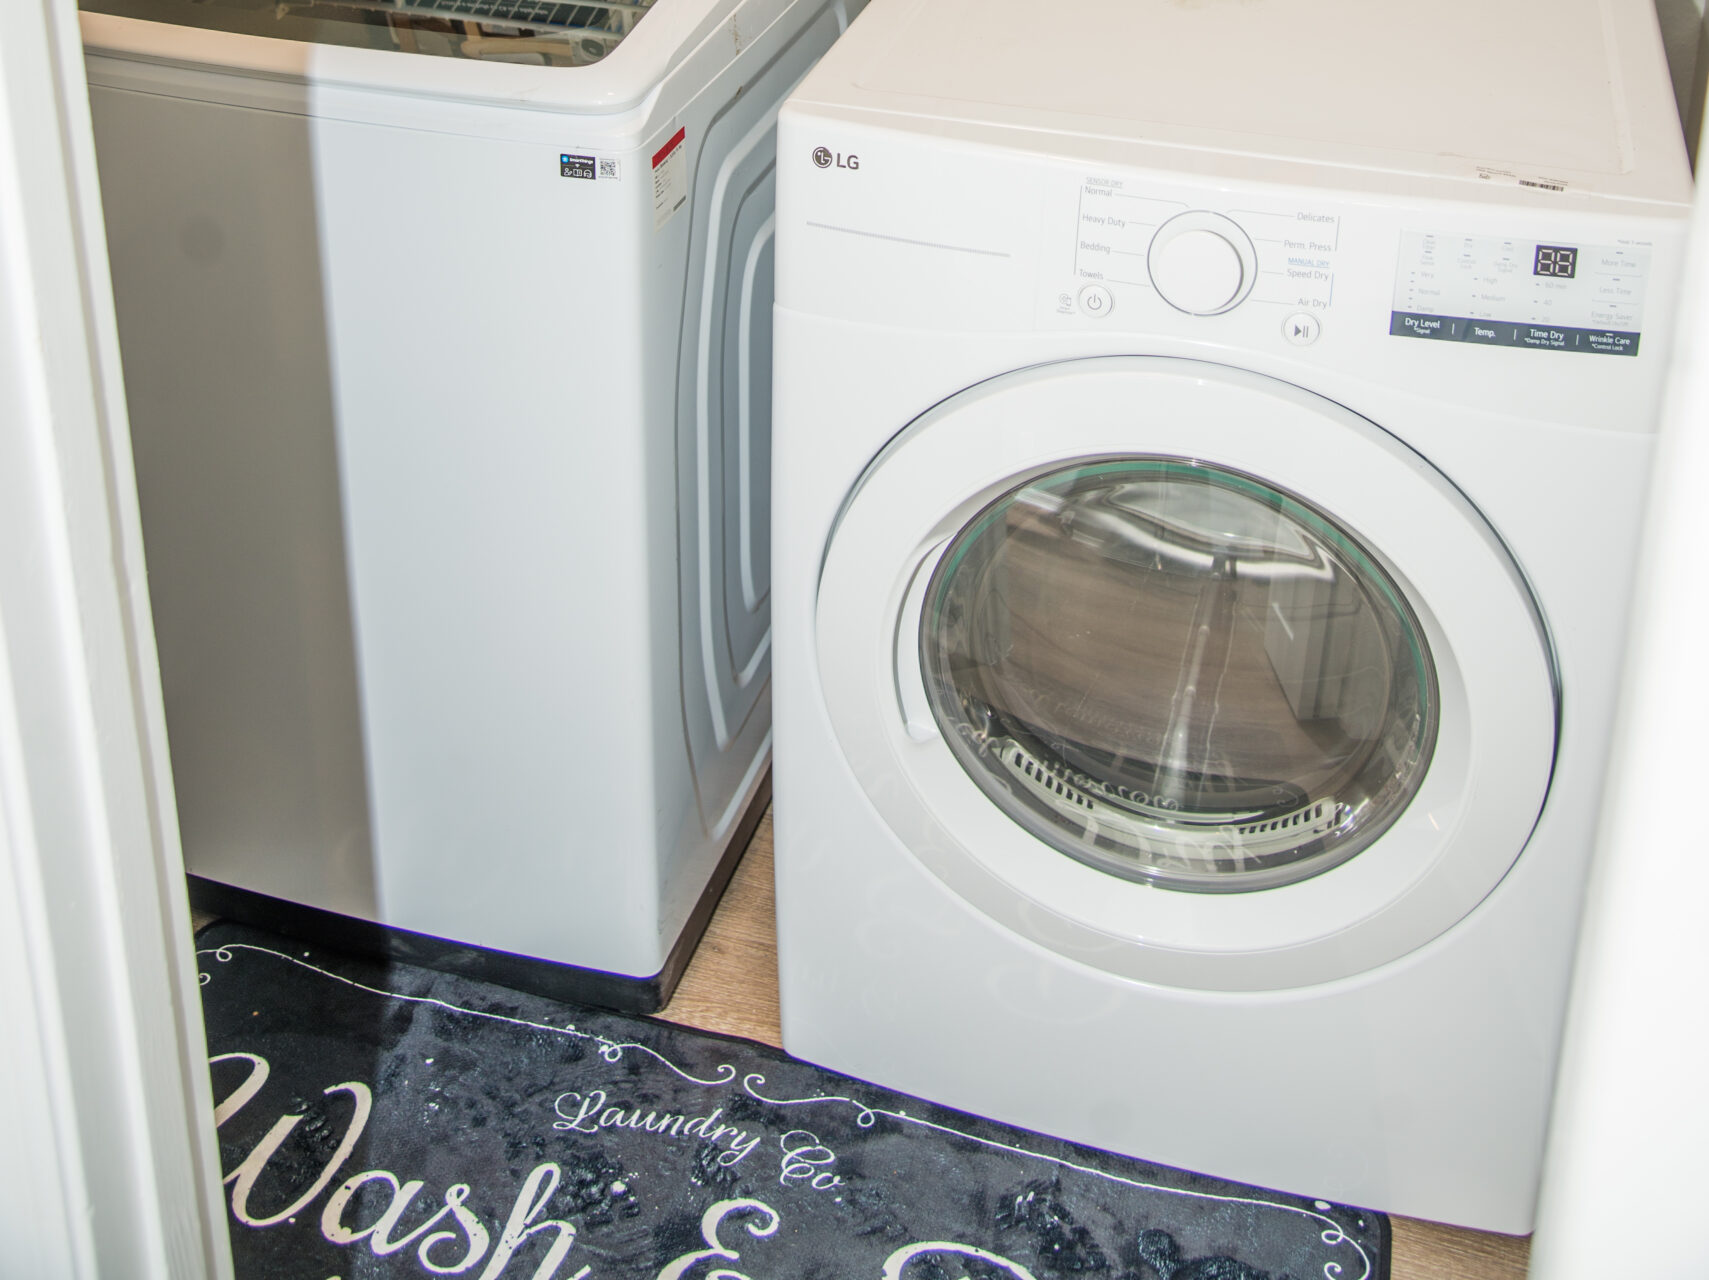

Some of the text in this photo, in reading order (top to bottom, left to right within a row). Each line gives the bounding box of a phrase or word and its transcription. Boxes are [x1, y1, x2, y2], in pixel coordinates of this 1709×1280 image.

[836, 152, 859, 170] LG
[1085, 186, 1113, 197] Normal
[1082, 213, 1126, 229] Heavy Duty
[1297, 212, 1335, 224] Delicates
[1080, 241, 1111, 255] Bedding
[1284, 240, 1332, 252] Perm. Press
[1288, 257, 1330, 268] MANUAL DRY
[1079, 268, 1104, 280] Towels
[1286, 268, 1329, 282] Speed Dry
[1298, 298, 1327, 310] Air Dry
[1405, 318, 1440, 328] Dry Level
[1474, 327, 1496, 338] Temp.
[1530, 328, 1564, 340] Time Dry
[1589, 335, 1630, 345] Wrinkle Care
[552, 1089, 846, 1203] Laundry Co.
